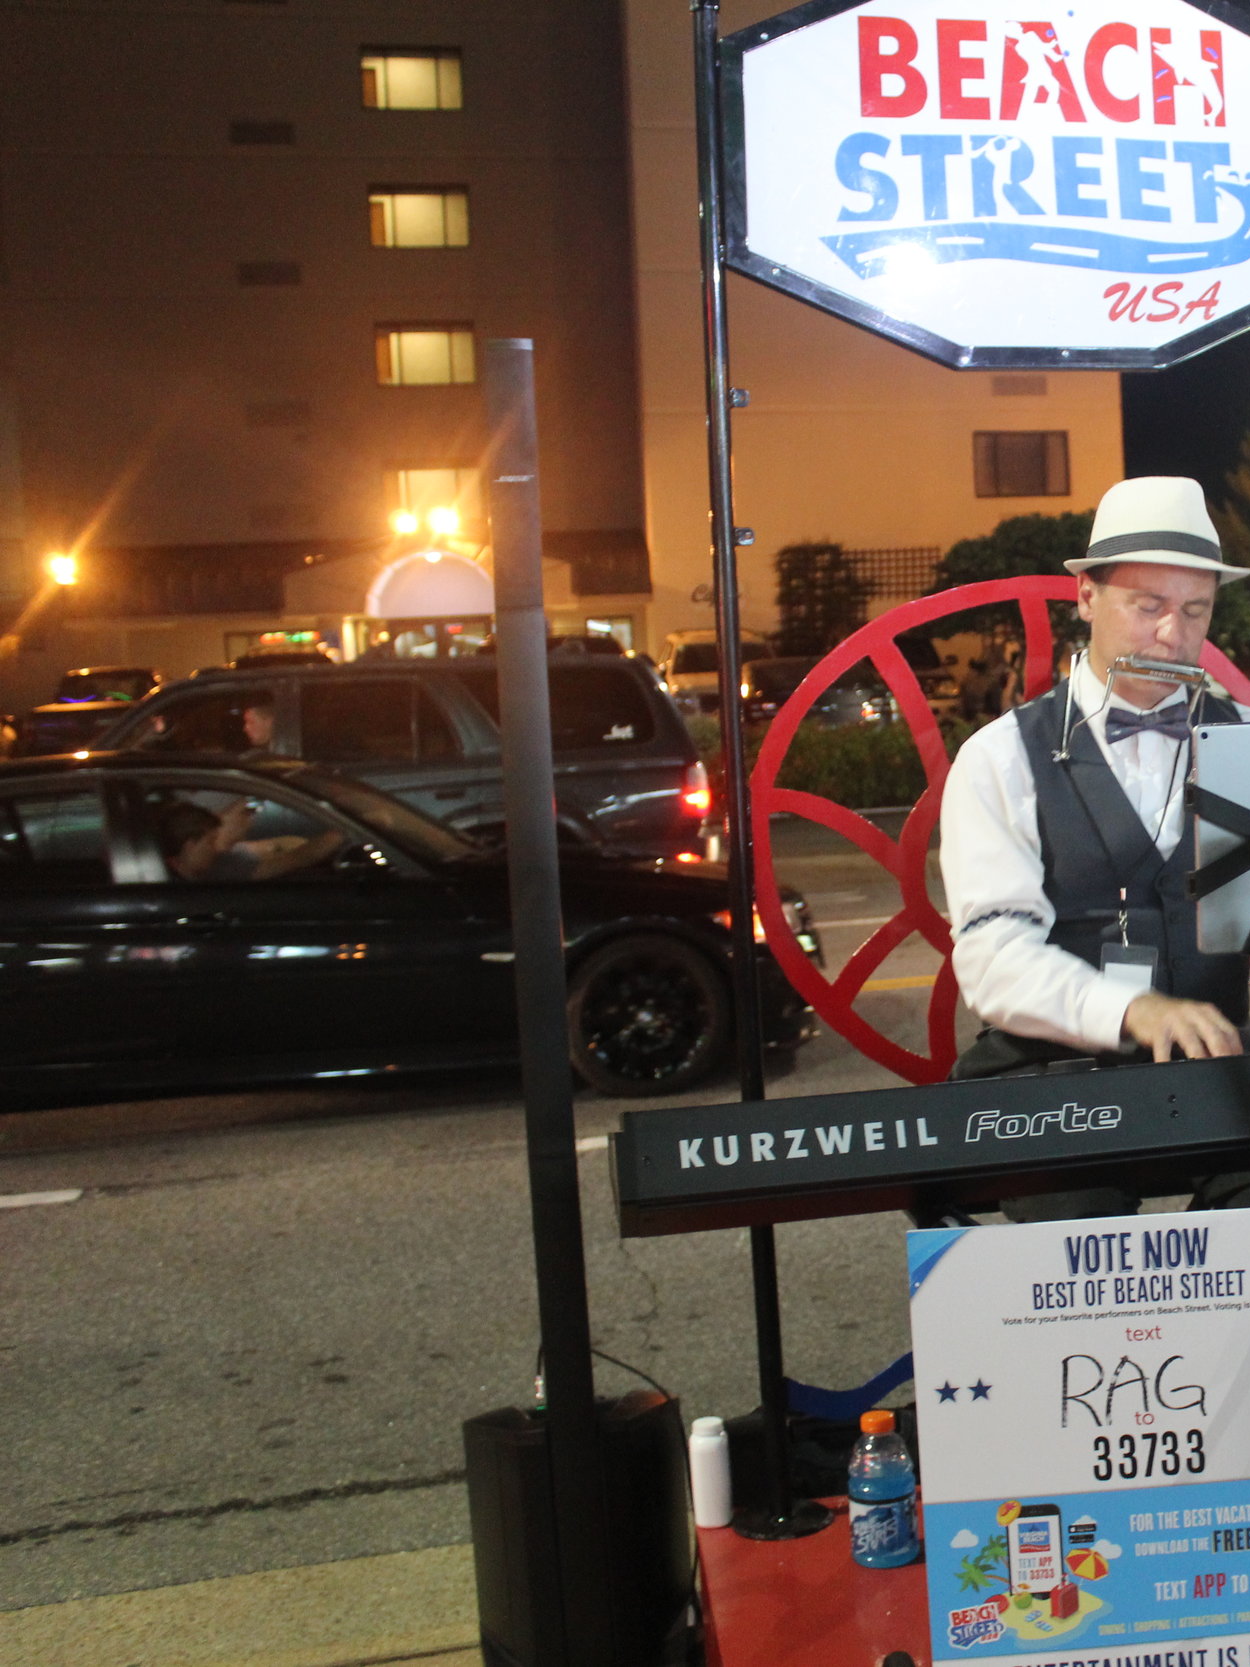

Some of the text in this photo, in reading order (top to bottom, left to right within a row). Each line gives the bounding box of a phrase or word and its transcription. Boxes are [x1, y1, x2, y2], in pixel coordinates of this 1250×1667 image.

[857, 15, 1227, 127] BEACH
[834, 131, 1232, 224] STREET
[1102, 280, 1221, 324] USA
[678, 1103, 1121, 1169] KURZWEIL Forte
[1065, 1227, 1209, 1277] VOTE NOW
[1032, 1270, 1246, 1310] BEST OF BEACH STREET
[1002, 1317, 1022, 1326] Vote
[1024, 1315, 1037, 1325] for
[1038, 1314, 1058, 1325] your
[1060, 1312, 1093, 1322] favorite
[1094, 1308, 1142, 1321] performers
[1143, 1308, 1155, 1316] on
[1157, 1304, 1183, 1315] Beach
[1213, 1300, 1242, 1312] Voting
[1243, 1300, 1250, 1309] is
[1125, 1325, 1162, 1343] text
[1061, 1354, 1207, 1428] RAG
[1134, 1410, 1155, 1426] to
[1093, 1428, 1207, 1482] 33733
[1129, 1513, 1154, 1532] FOR
[1157, 1511, 1181, 1530] THE
[1183, 1508, 1213, 1529] BEST
[1135, 1538, 1189, 1557] DOWNLOAD
[1192, 1536, 1209, 1552] THE
[1154, 1580, 1187, 1601] TEXT
[1193, 1573, 1226, 1599] APP
[1231, 1574, 1248, 1594] TO
[1218, 1646, 1239, 1667] IS
